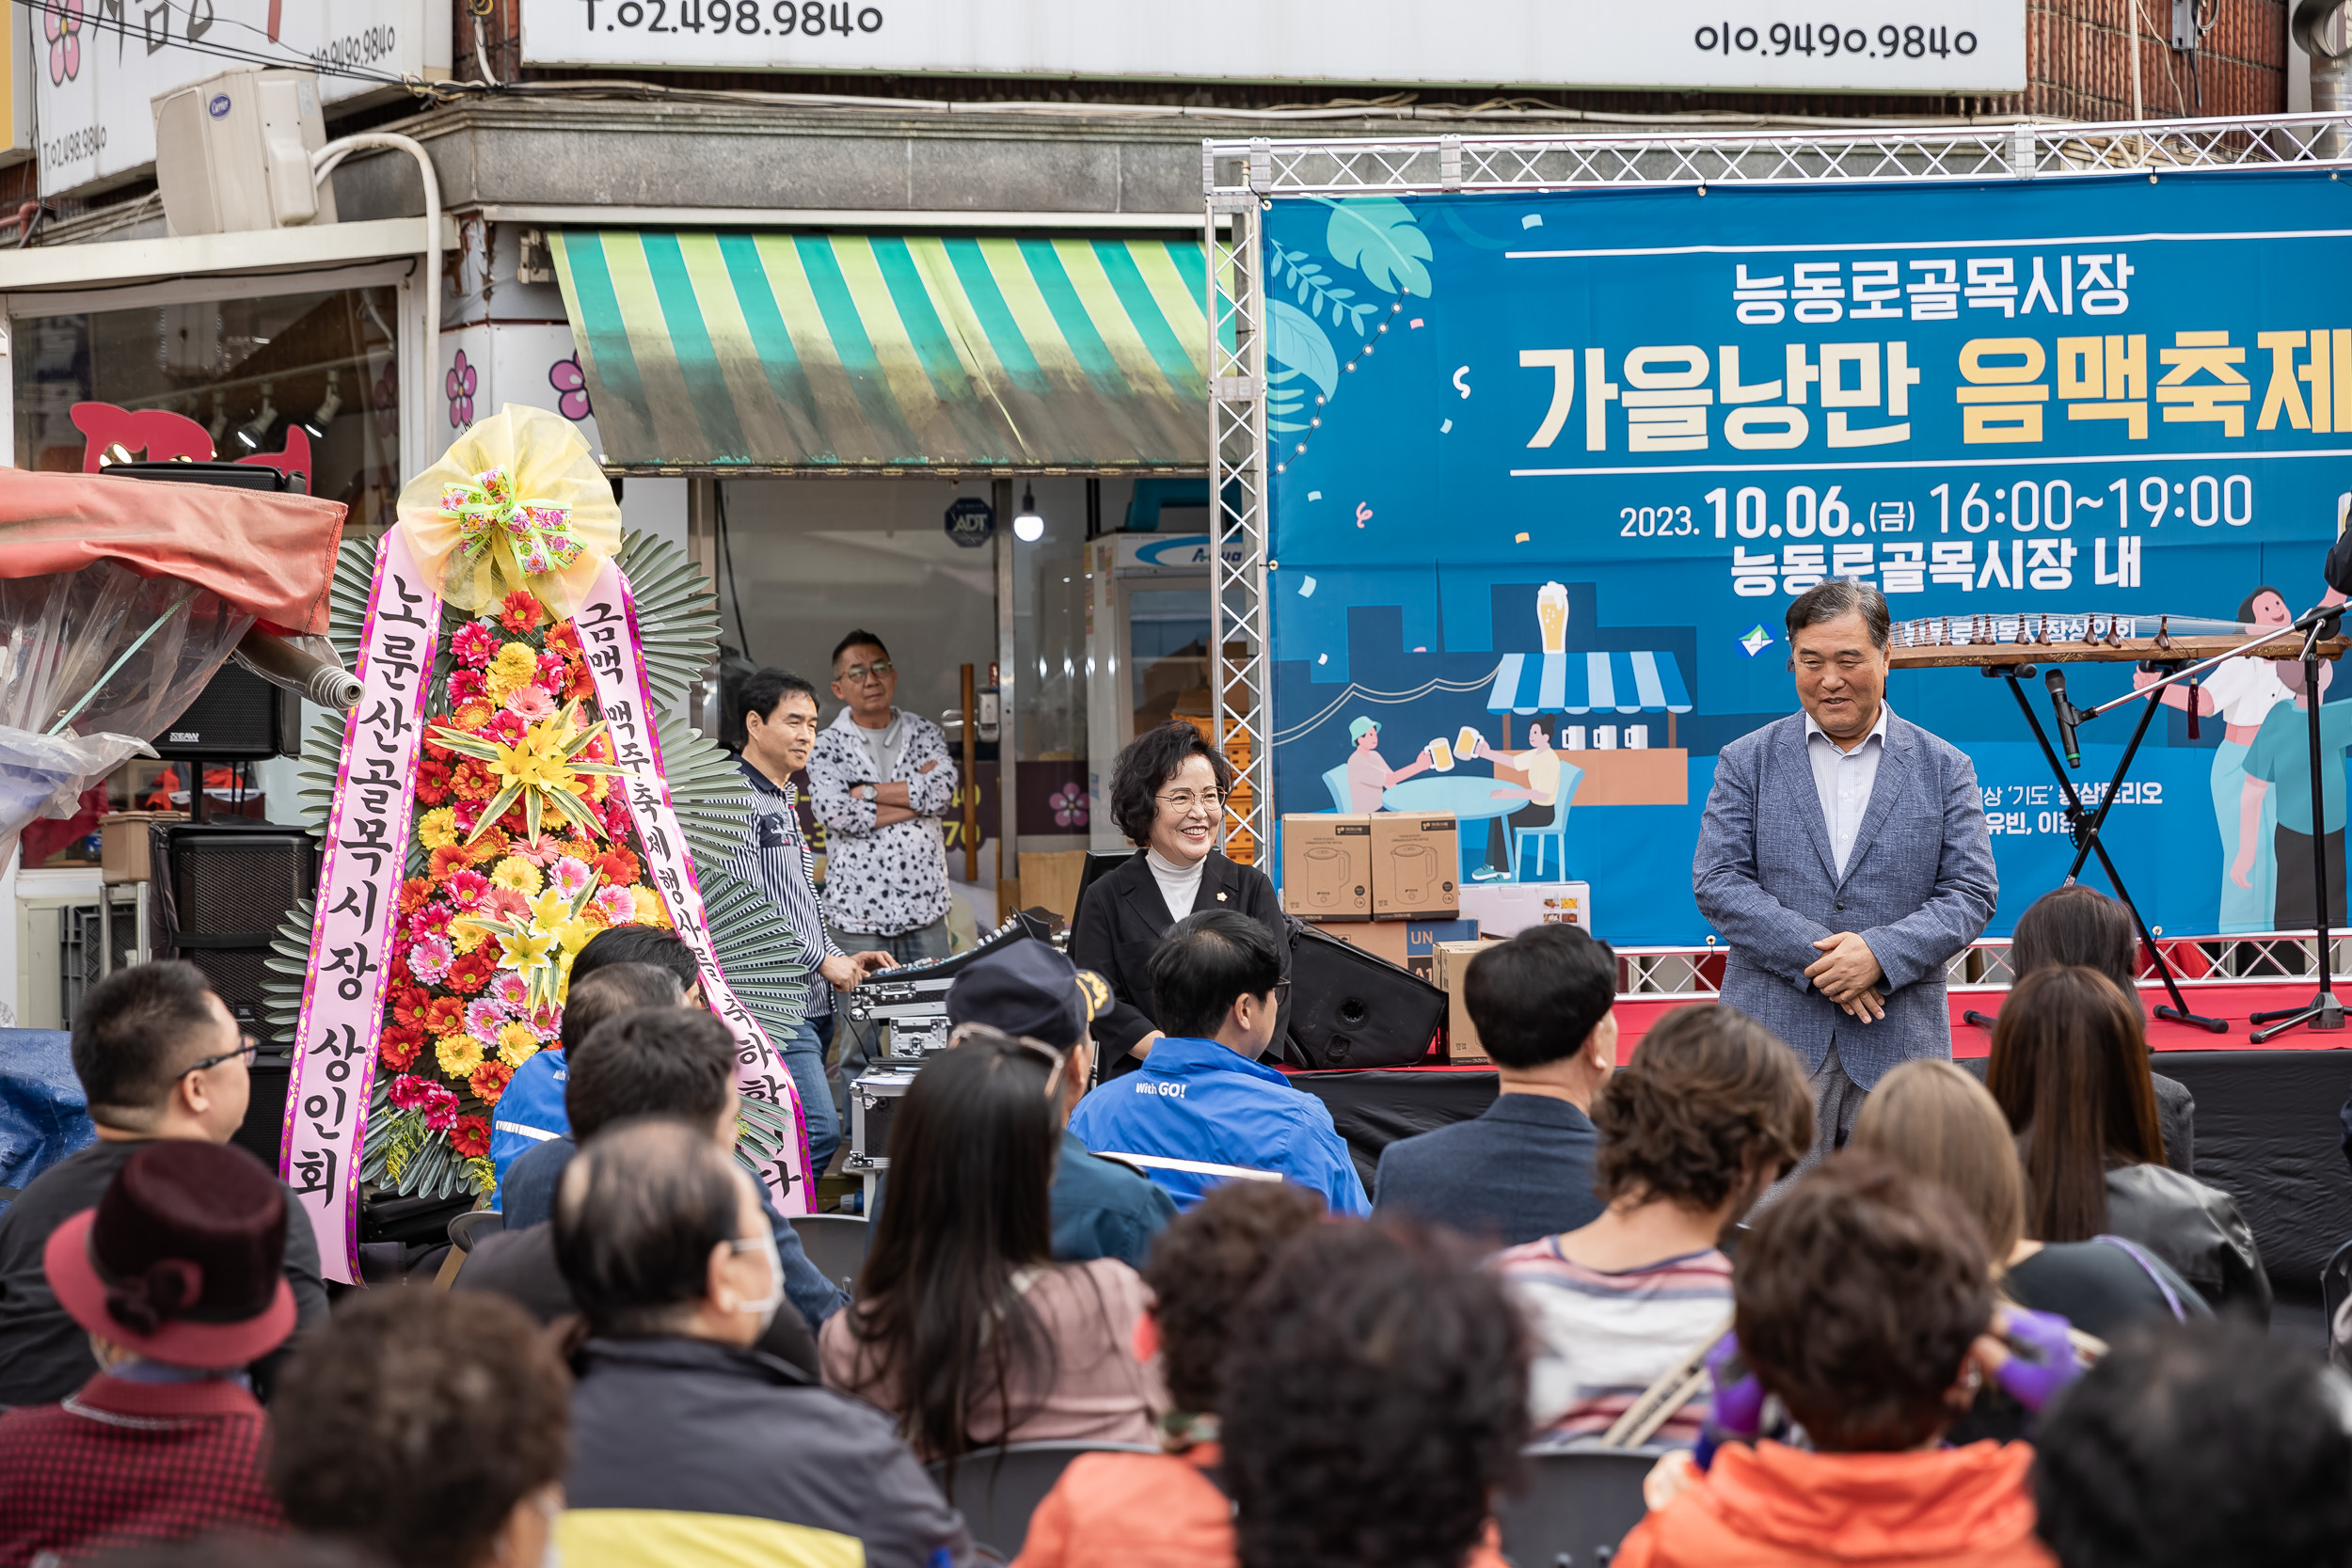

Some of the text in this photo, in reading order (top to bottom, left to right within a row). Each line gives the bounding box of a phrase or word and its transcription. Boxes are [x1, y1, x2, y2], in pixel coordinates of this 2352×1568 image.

[1694, 22, 1978, 58] 010.9490.9840
[42, 124, 107, 172] T.02.498.9840
[1732, 252, 2136, 325] 능동로골목시장
[1518, 328, 2352, 452] 가을낭만 음맥축제
[953, 513, 988, 531] ADT
[1929, 473, 2253, 534] 16:00~19:00
[1730, 535, 2142, 597] 능동로골목시장 내
[578, 601, 625, 686] 금맥
[293, 574, 426, 1209] 노룬산골목시장 상인회
[1136, 1082, 1187, 1099] With GO!
